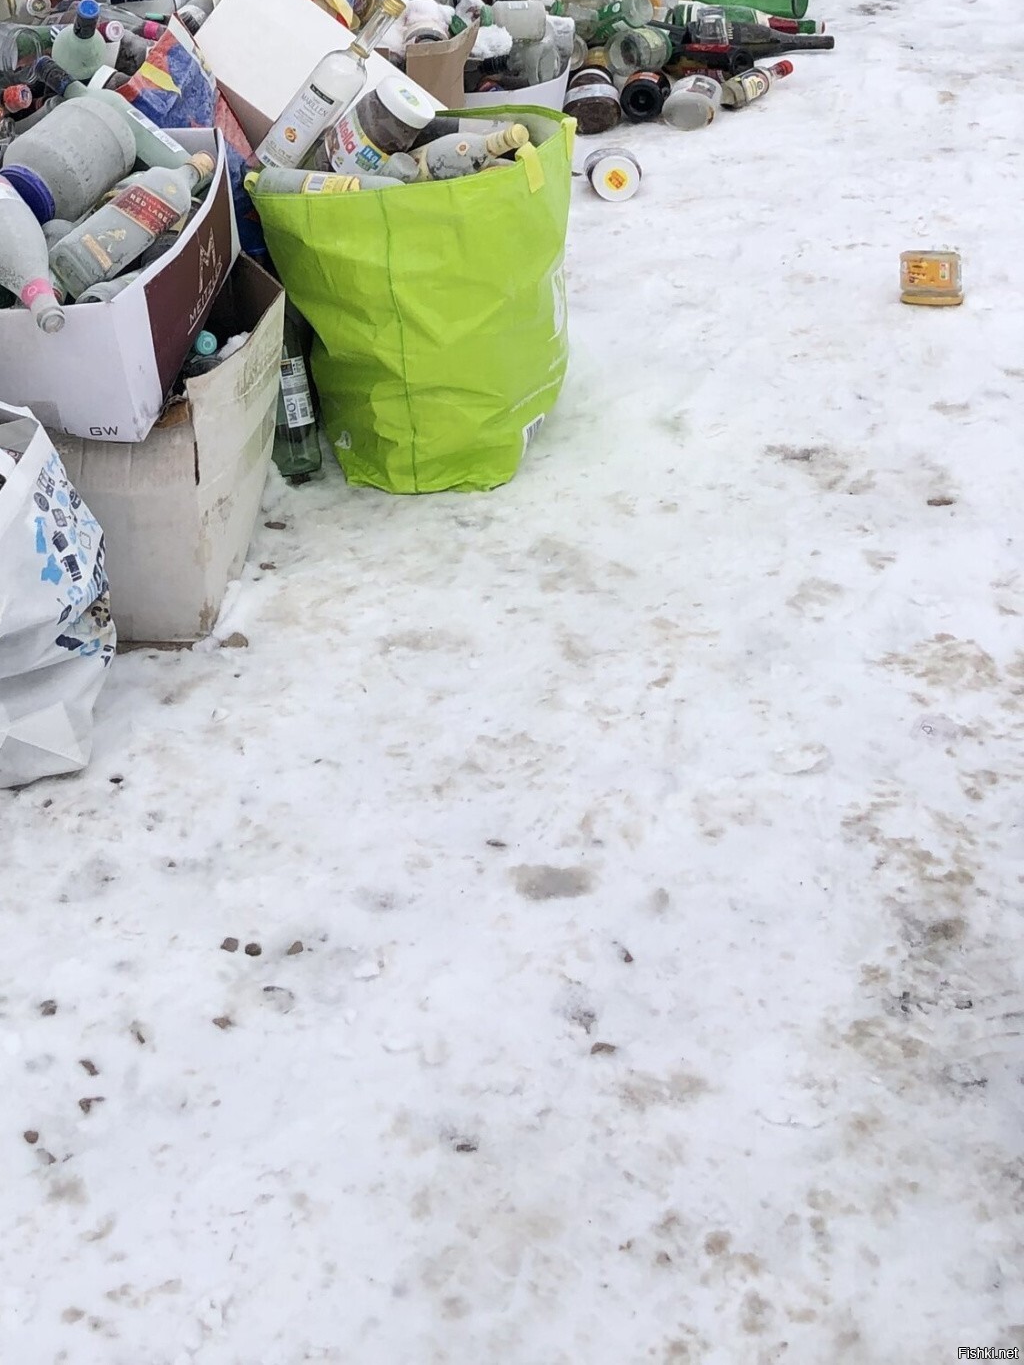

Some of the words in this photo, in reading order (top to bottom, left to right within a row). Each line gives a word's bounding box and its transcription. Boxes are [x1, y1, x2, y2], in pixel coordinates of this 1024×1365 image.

[301, 92, 329, 117] MARILLEN
[129, 192, 147, 207] RED
[89, 425, 119, 436] GW
